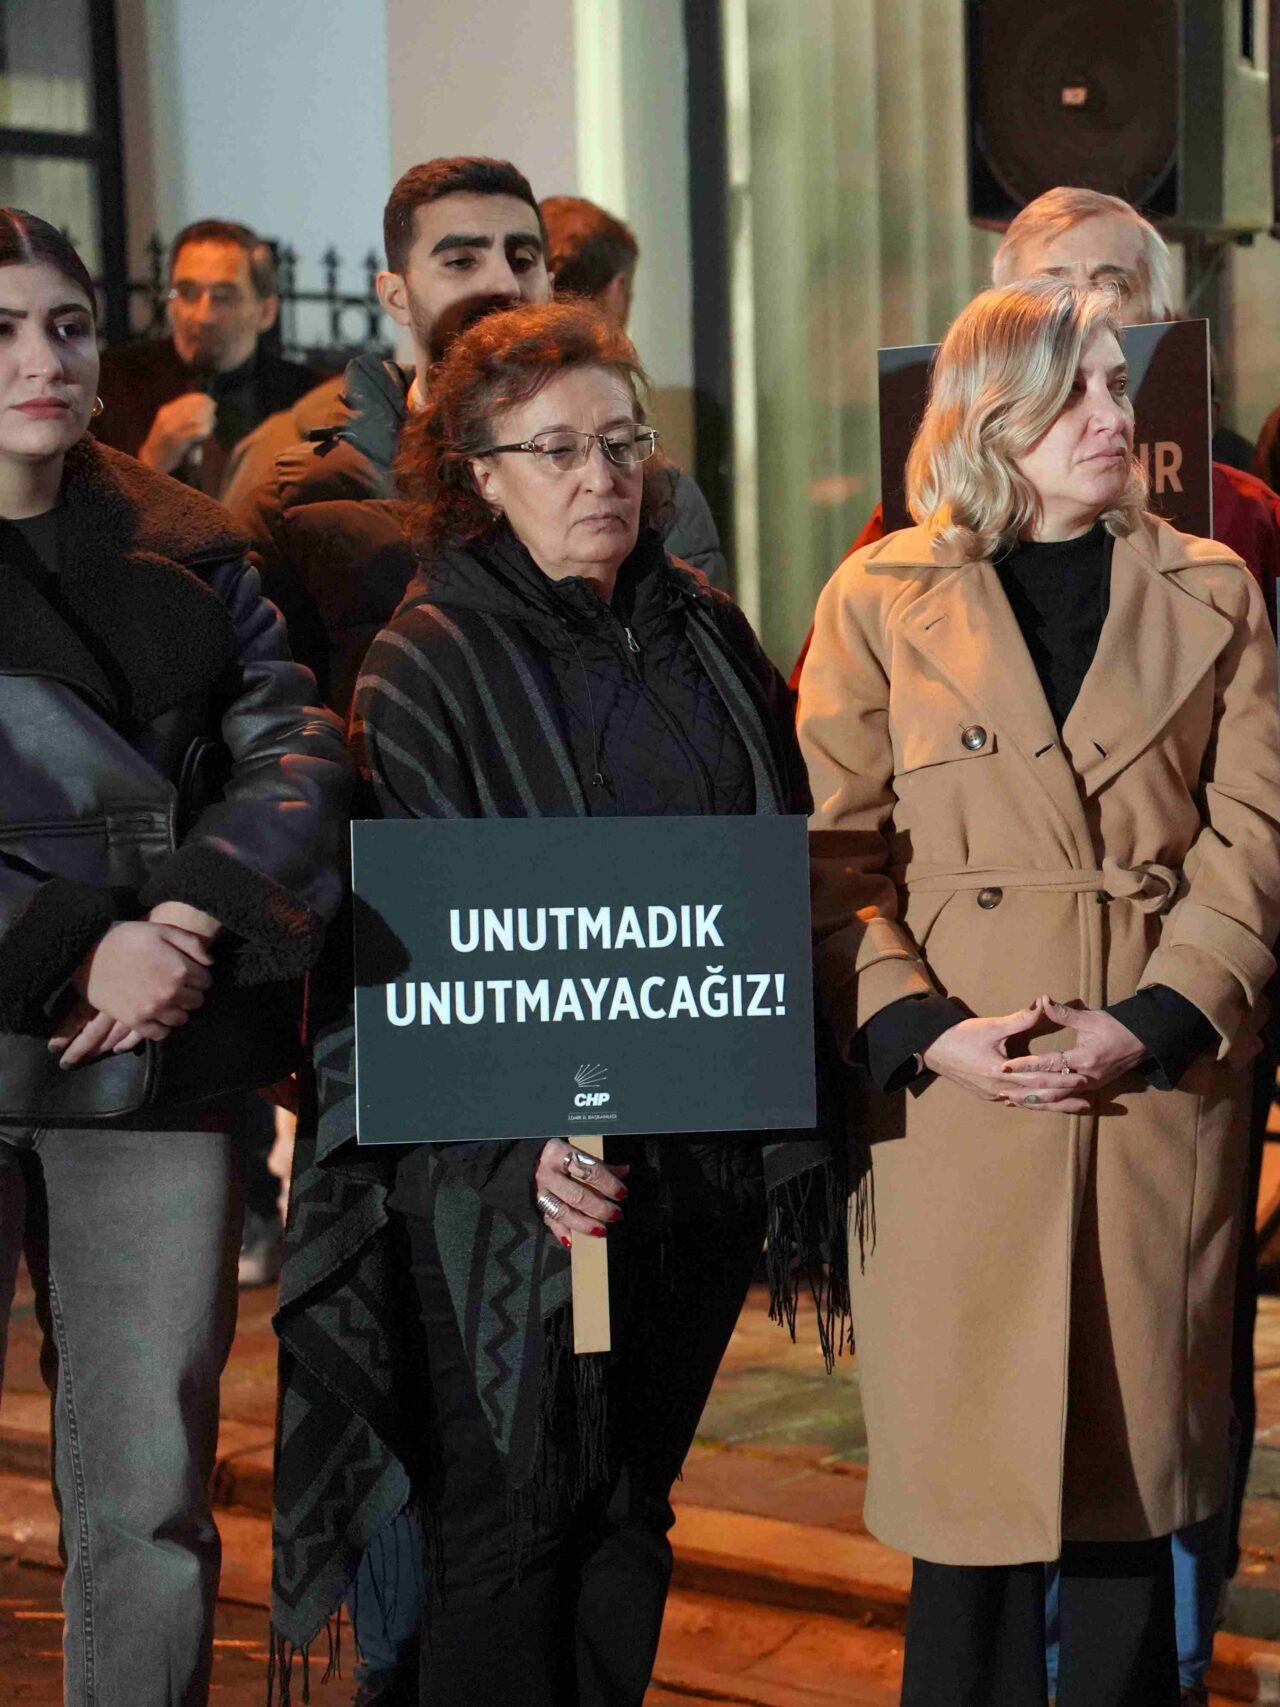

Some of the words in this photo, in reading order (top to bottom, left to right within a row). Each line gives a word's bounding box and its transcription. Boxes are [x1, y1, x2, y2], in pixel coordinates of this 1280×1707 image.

[449, 904, 725, 953] UNUTMADIK
[385, 965, 787, 1027] UNUTMAYACAĞIZ!
[574, 1092, 610, 1107] CHP
